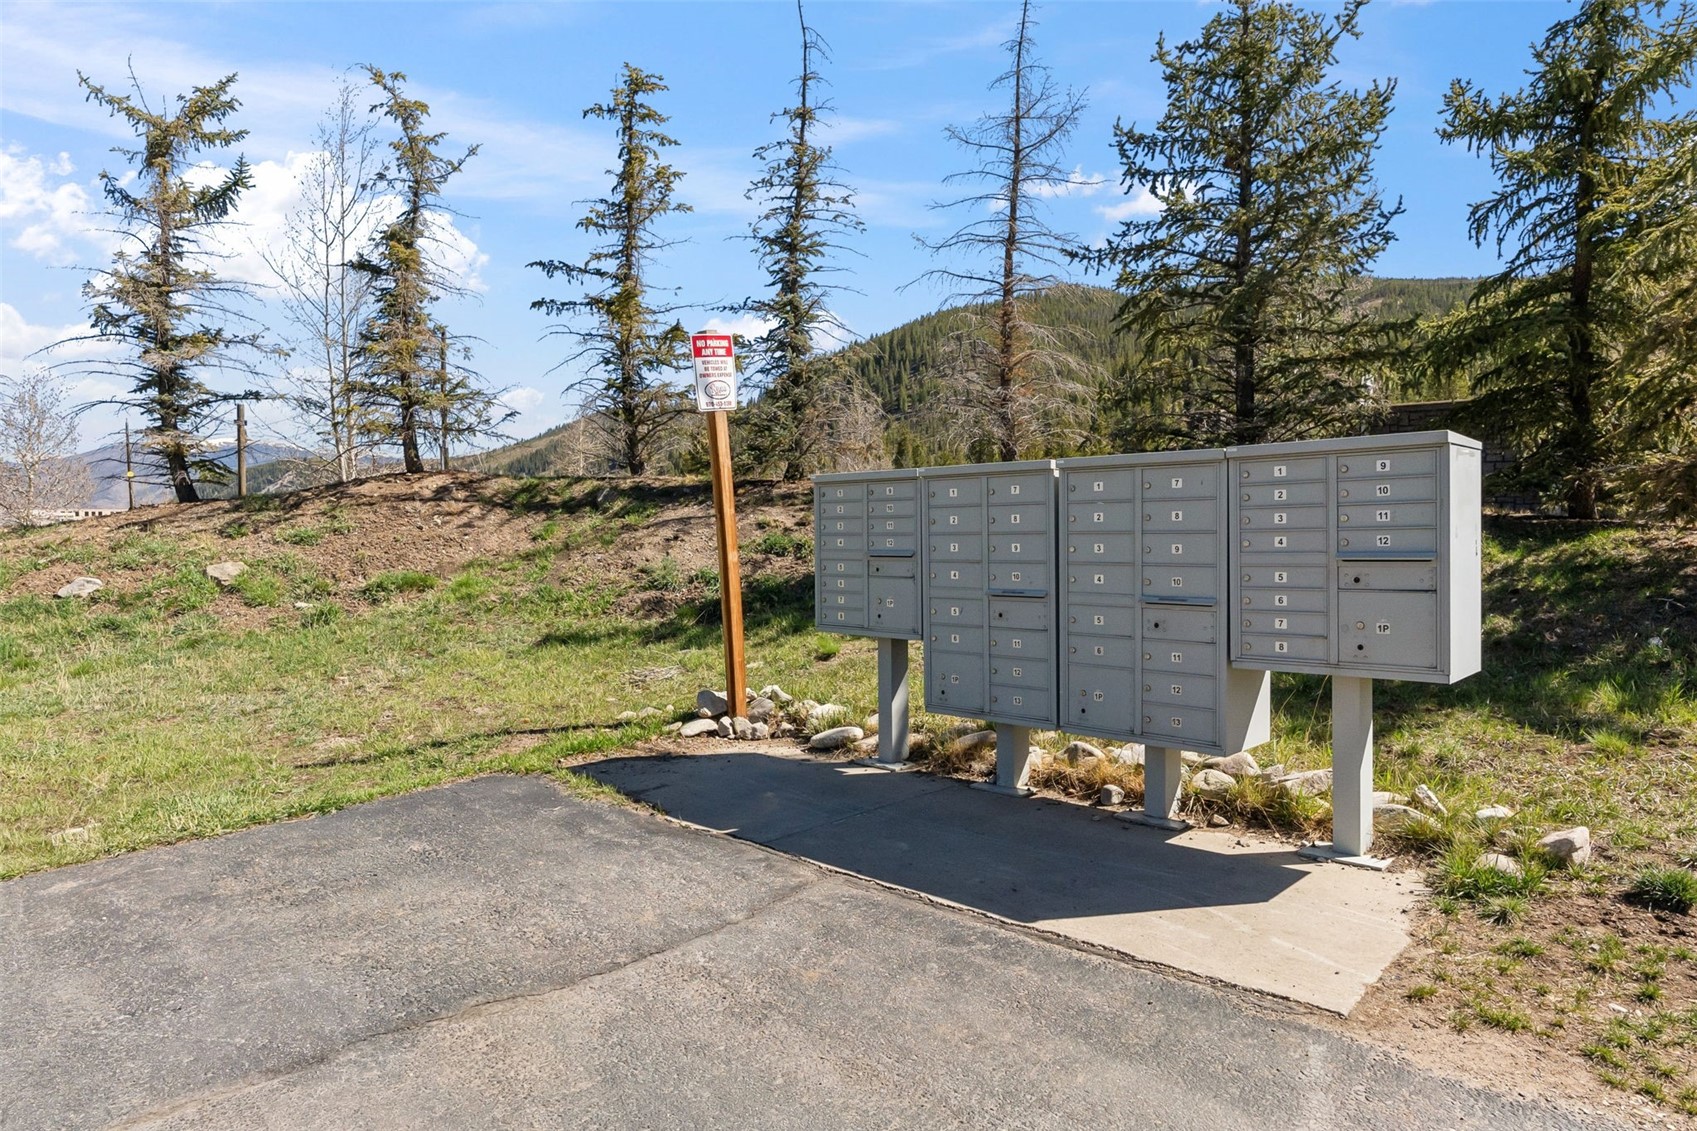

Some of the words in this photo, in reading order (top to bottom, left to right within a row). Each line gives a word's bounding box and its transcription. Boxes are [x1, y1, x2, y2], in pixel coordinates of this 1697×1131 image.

[1380, 461, 1387, 470] 9
[1278, 491, 1283, 499] 2
[1378, 486, 1389, 495] 10
[1277, 514, 1284, 523] 3
[1378, 512, 1388, 520] 11
[1378, 536, 1389, 545] 12
[1172, 578, 1181, 586] 10
[1278, 573, 1284, 582] 5
[1278, 596, 1284, 605] 6
[1278, 619, 1284, 627] 7
[1377, 624, 1390, 633] 1P
[1278, 643, 1285, 651] 8
[1172, 686, 1181, 694] 12
[1094, 690, 1103, 700] 1P
[1172, 718, 1181, 726] 13
